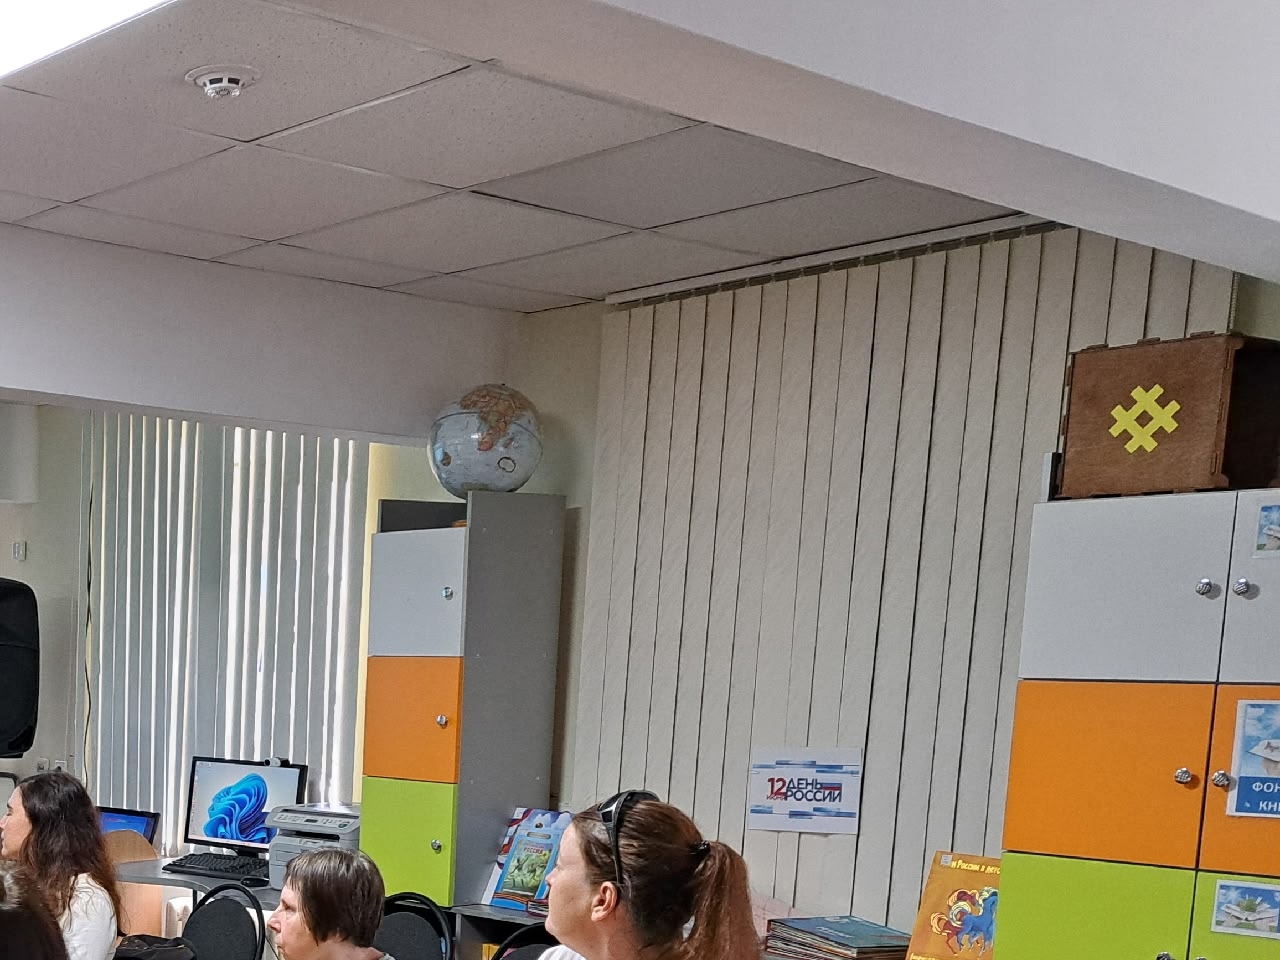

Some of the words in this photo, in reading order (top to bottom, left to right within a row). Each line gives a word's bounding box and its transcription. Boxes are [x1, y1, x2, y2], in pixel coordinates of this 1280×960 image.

[767, 777, 787, 796] 12
[786, 777, 823, 790] ДЕНЬ
[785, 789, 842, 803] РОССИИ
